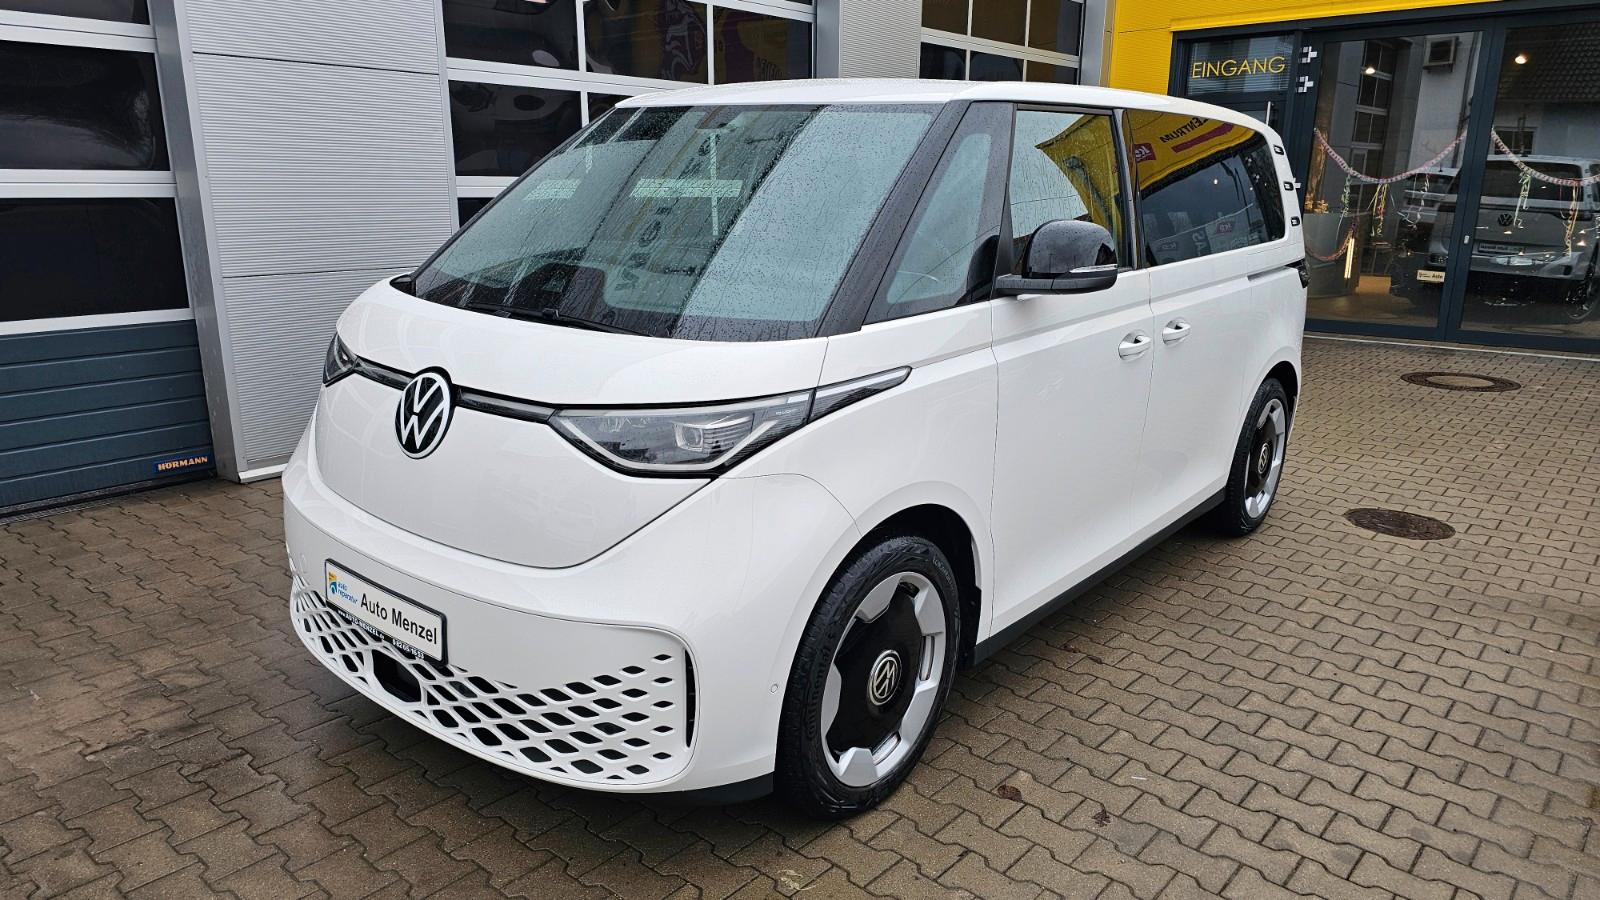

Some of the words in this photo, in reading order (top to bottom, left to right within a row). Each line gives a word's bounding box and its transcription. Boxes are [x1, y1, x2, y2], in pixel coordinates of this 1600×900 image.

[1191, 56, 1287, 79] EINGANG
[400, 372, 451, 459] VW
[360, 592, 388, 620] Auto
[392, 607, 438, 645] Menzel
